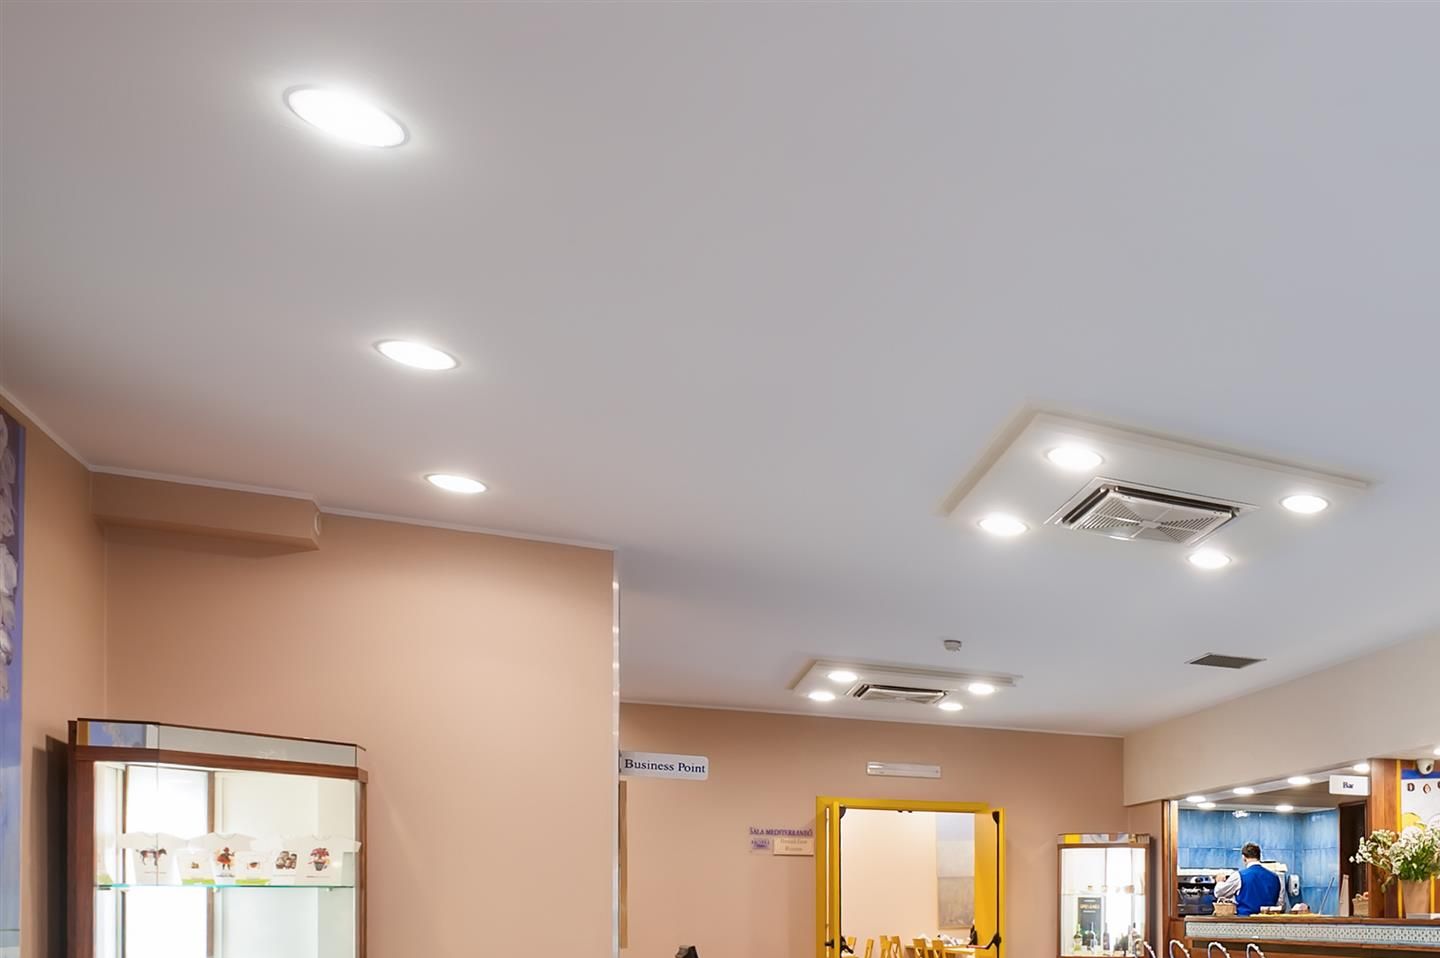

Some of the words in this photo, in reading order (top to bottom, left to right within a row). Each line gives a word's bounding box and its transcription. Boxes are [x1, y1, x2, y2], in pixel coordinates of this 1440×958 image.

[624, 758, 675, 772] Business
[677, 762, 706, 774] Point
[1342, 781, 1354, 789] Bar
